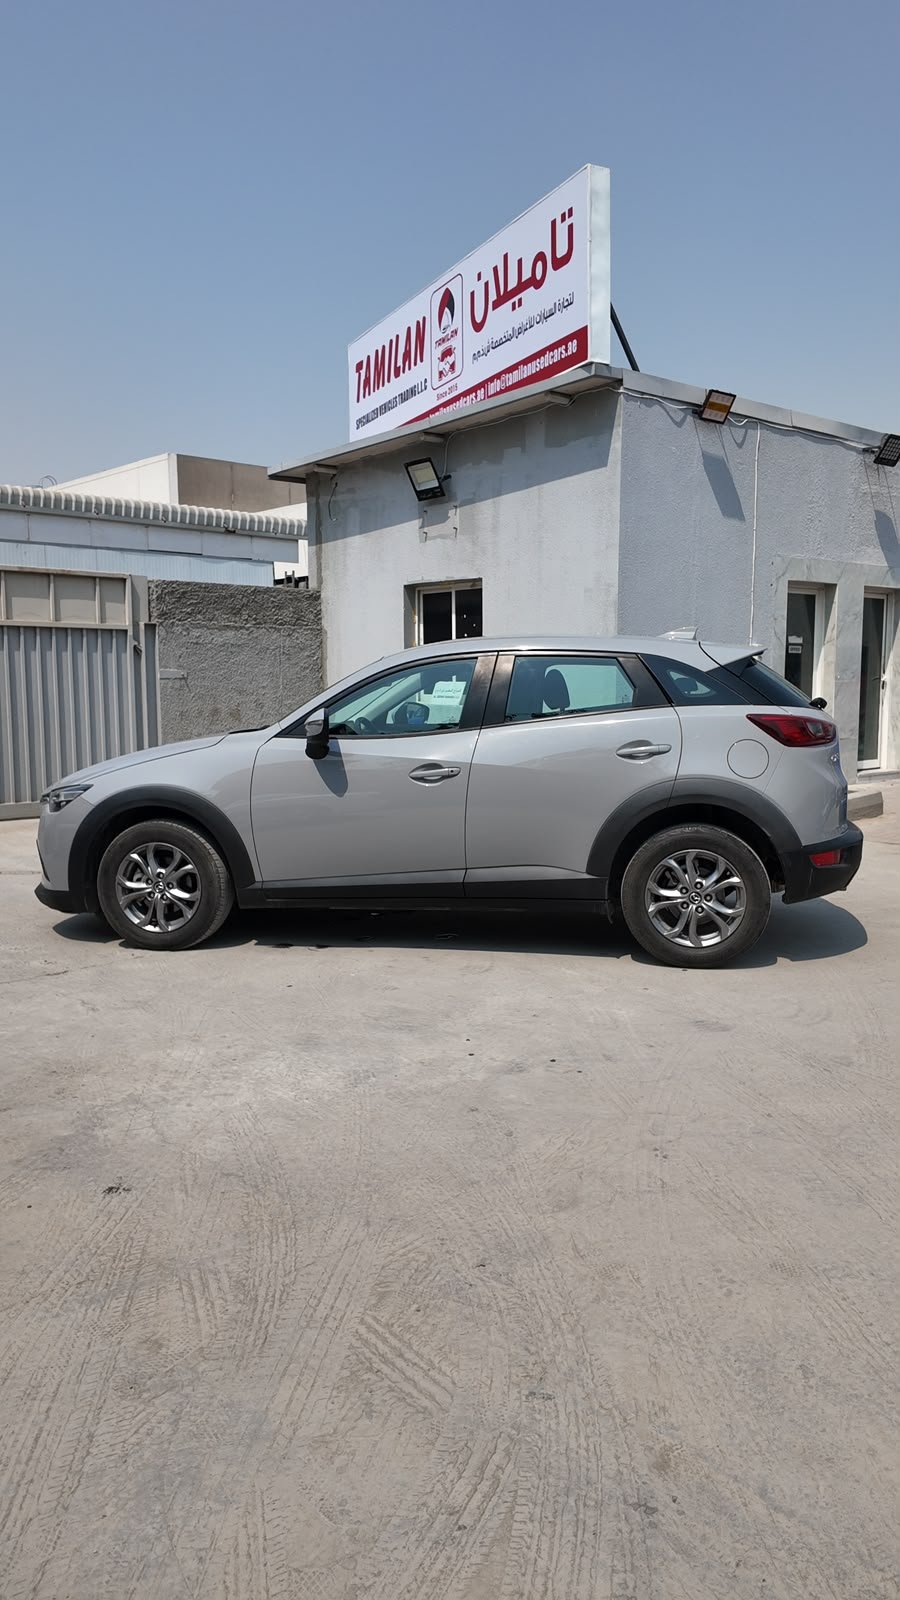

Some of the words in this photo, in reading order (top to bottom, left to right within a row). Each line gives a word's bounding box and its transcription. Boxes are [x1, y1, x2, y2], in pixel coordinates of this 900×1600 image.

[470, 207, 573, 333] تاميلان
[535, 302, 557, 325] السيارات
[558, 291, 574, 314] لتجارة
[435, 328, 458, 349] TAMILAN
[355, 316, 427, 403] TAMILAN
[487, 338, 578, 396] info@tamilanusedcars.ae
[356, 407, 378, 430] SPECIALIZED
[379, 395, 398, 417] VEHICLES
[398, 384, 416, 406] TRADING
[436, 390, 448, 401] Since
